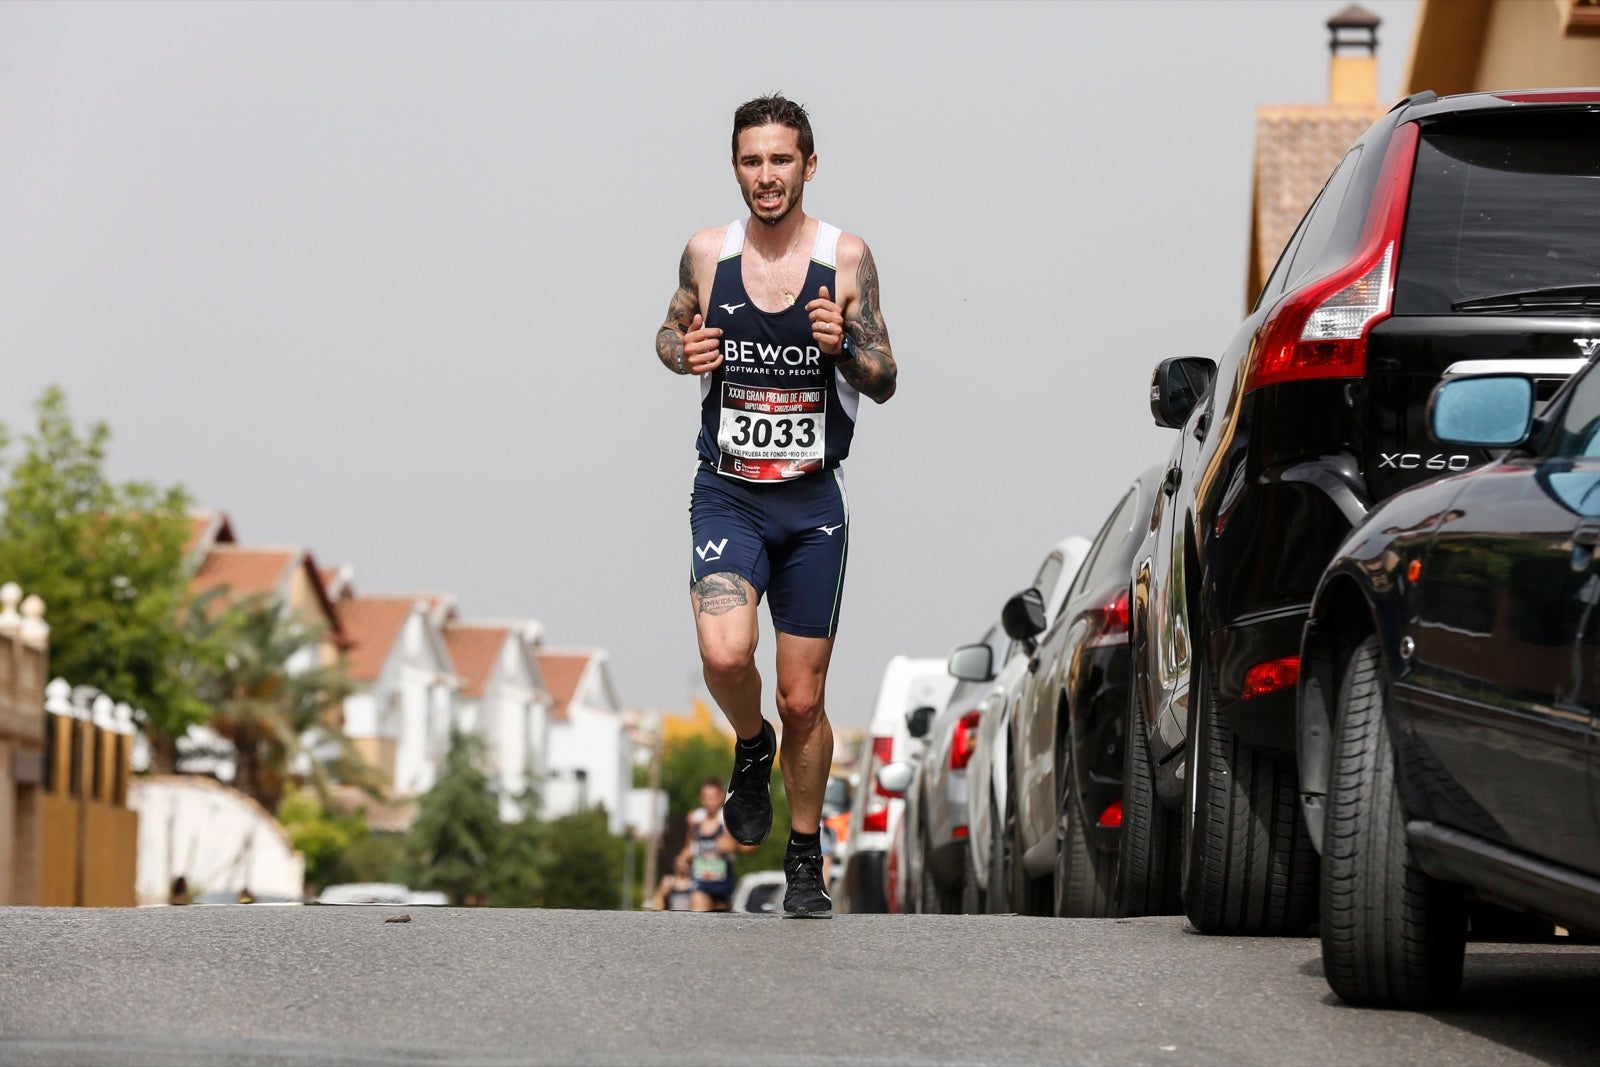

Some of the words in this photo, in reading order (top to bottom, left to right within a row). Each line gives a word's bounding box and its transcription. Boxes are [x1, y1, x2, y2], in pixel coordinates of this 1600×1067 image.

[724, 340, 820, 366] BEWOR
[725, 366, 770, 374] SOFTWARE
[746, 390, 764, 402] GRAN
[765, 391, 789, 403] PREMIO
[790, 392, 799, 402] DE
[799, 391, 820, 401] FONDO
[774, 404, 803, 412] CRUZCAMPO
[731, 415, 816, 448] 3033
[742, 450, 762, 458] PRUEBA
